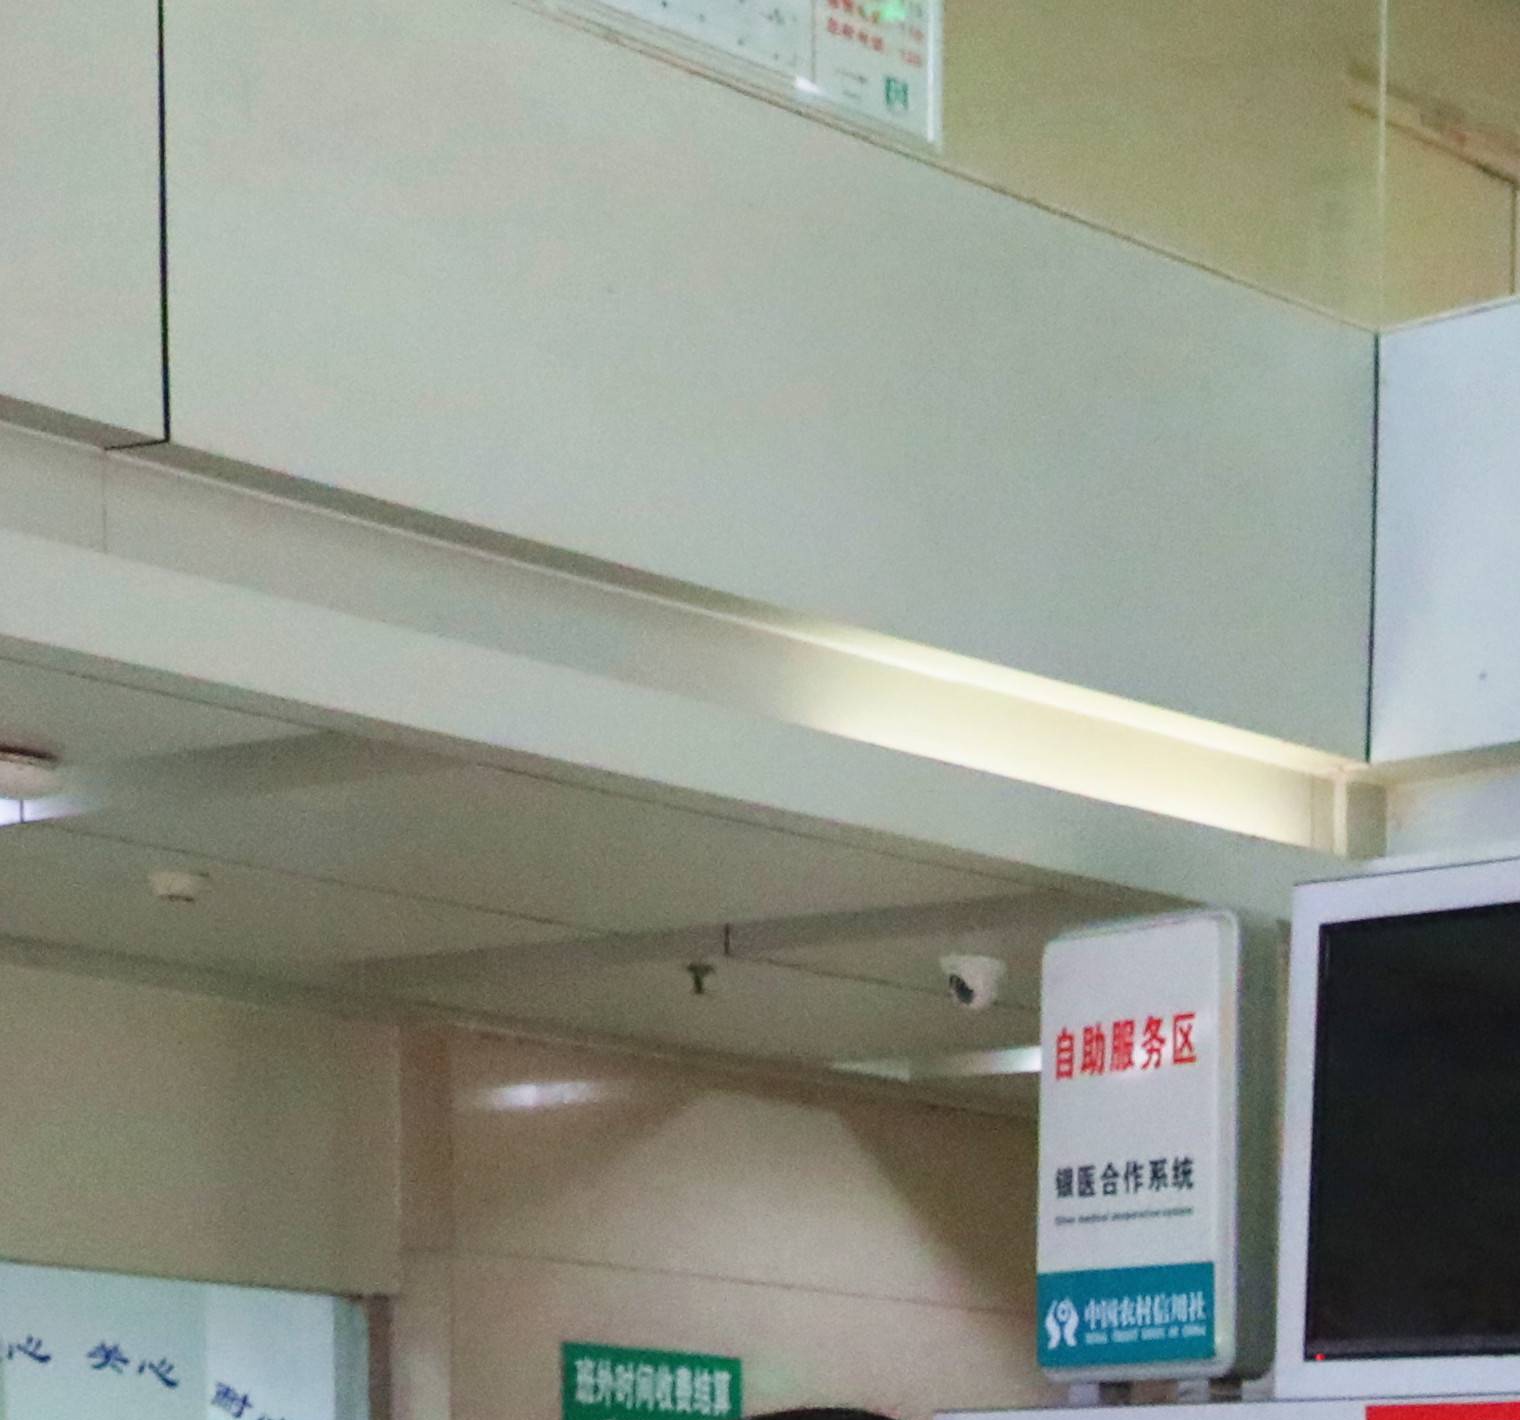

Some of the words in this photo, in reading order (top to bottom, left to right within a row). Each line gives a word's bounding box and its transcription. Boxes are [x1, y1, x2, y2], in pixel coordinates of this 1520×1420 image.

[1055, 1012, 1198, 1082] 自助服务区
[1055, 1156, 1195, 1201] 银医合作系统
